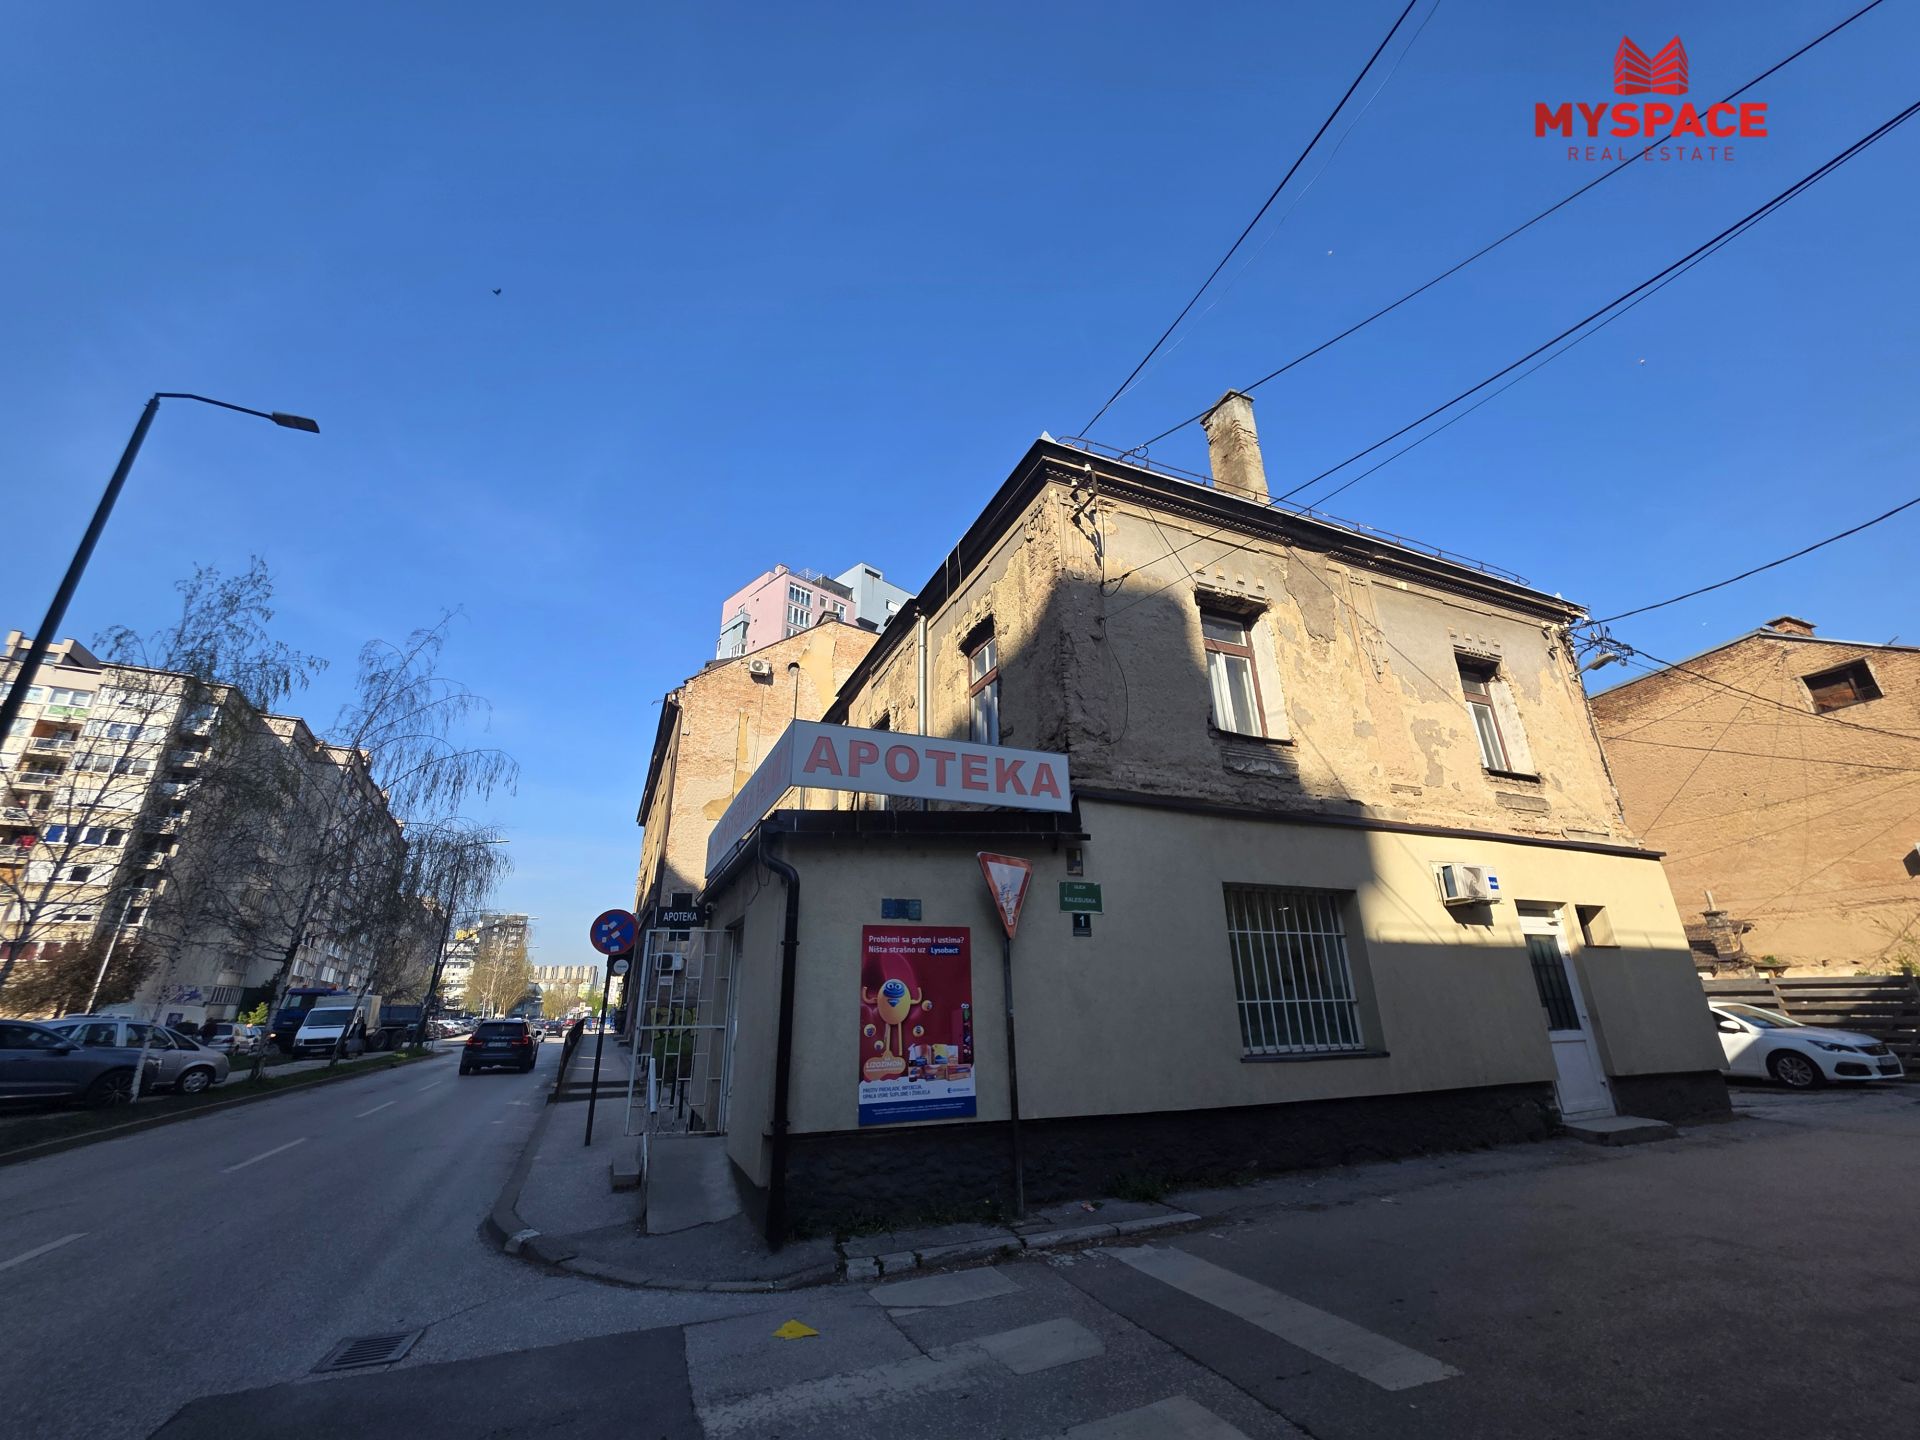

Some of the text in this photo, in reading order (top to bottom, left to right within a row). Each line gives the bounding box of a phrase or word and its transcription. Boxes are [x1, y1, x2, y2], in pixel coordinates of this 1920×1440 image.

[803, 736, 1061, 800] APOTEKA
[662, 911, 698, 922] APOTEKA
[1079, 915, 1085, 927] 1
[868, 935, 900, 944] Problemi
[911, 936, 931, 945] grlom
[937, 936, 965, 945] ustima?
[868, 945, 889, 954] Ništa
[889, 945, 916, 954] strašno
[930, 946, 959, 955] Lysobact
